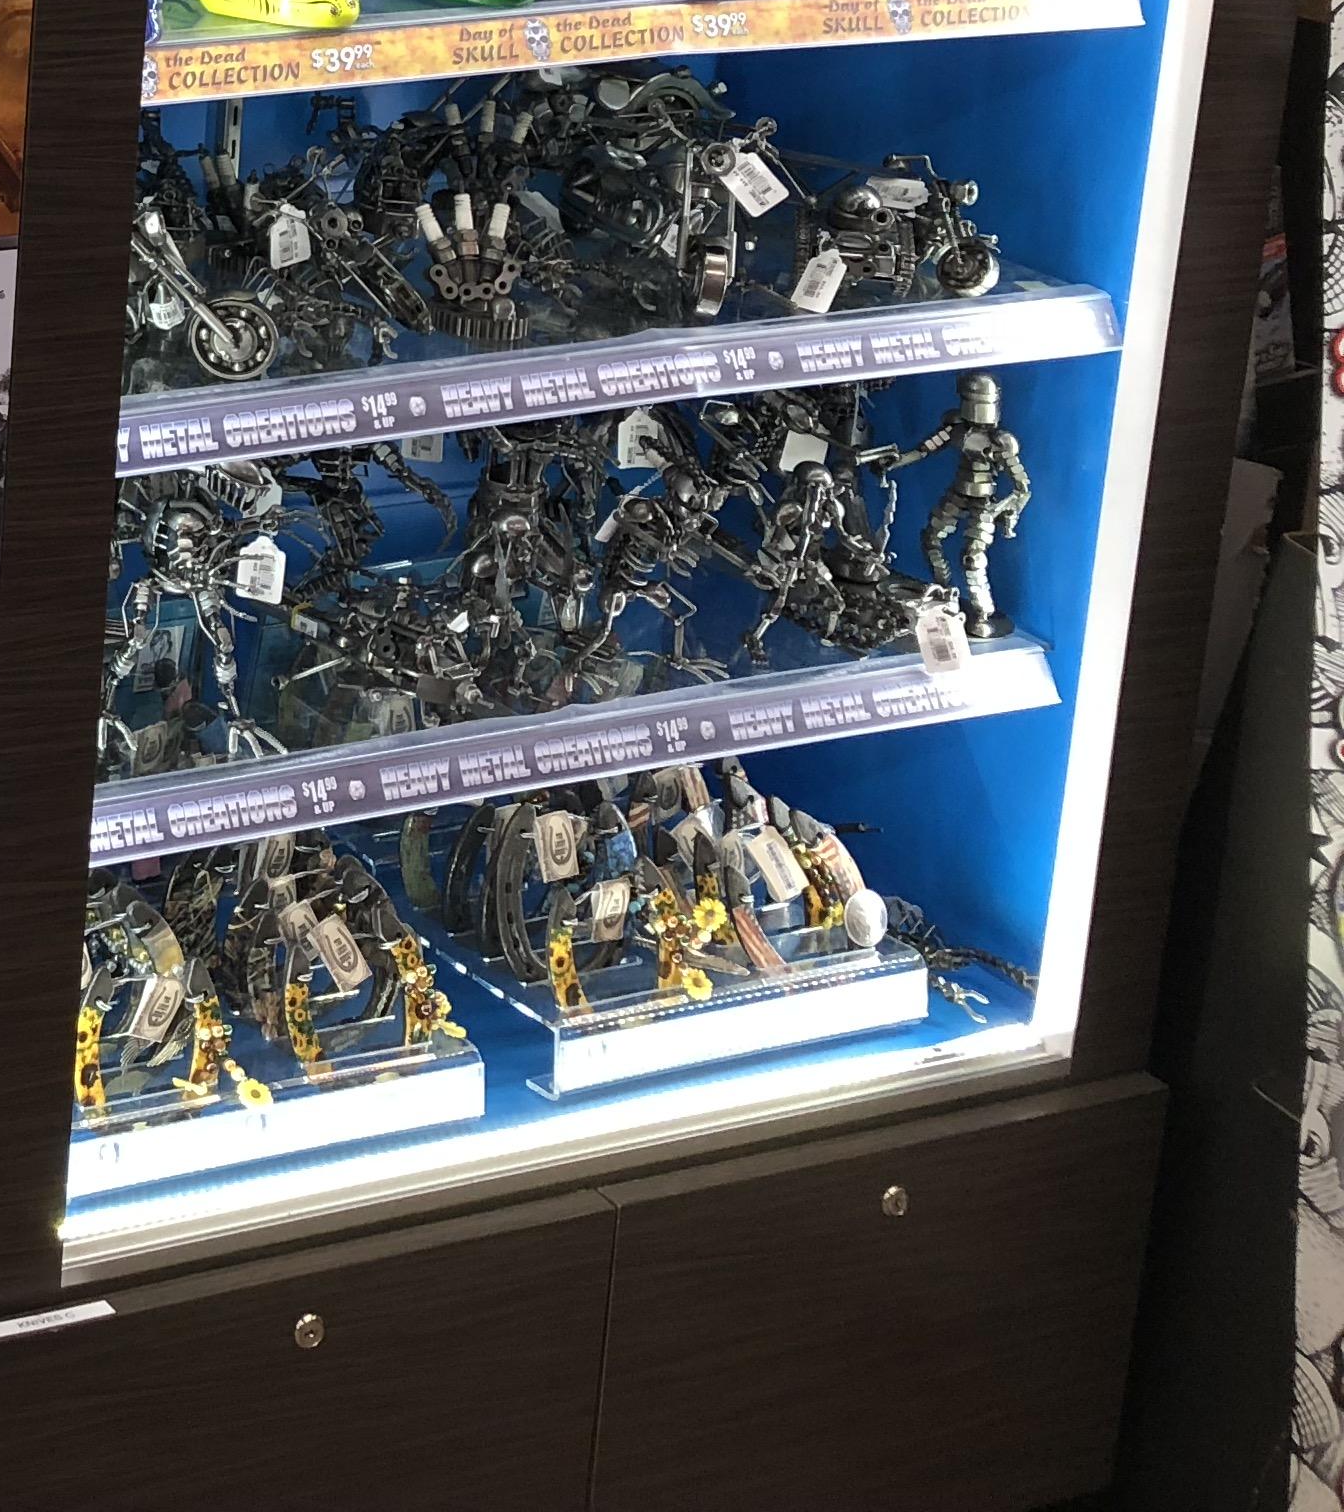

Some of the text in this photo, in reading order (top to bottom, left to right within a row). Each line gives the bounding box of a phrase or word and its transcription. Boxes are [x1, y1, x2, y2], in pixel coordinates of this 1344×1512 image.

[459, 27, 495, 45] Day
[556, 12, 632, 33] the Dead
[822, 10, 884, 36] SKULL
[452, 37, 519, 65] SKULL
[560, 24, 684, 54] COLLECTION
[166, 48, 246, 68] the Dead
[168, 62, 300, 90] COLLECTION
[796, 335, 863, 373] HEAVY
[870, 327, 940, 365] METAL
[440, 365, 596, 419] HEAVY METAL
[140, 398, 357, 459] METAL CREATIONS
[729, 699, 796, 742] HEAVY
[802, 689, 872, 730] METAL
[379, 743, 531, 802] HEAVY METAL
[90, 785, 297, 853] METAL CREATIONS
